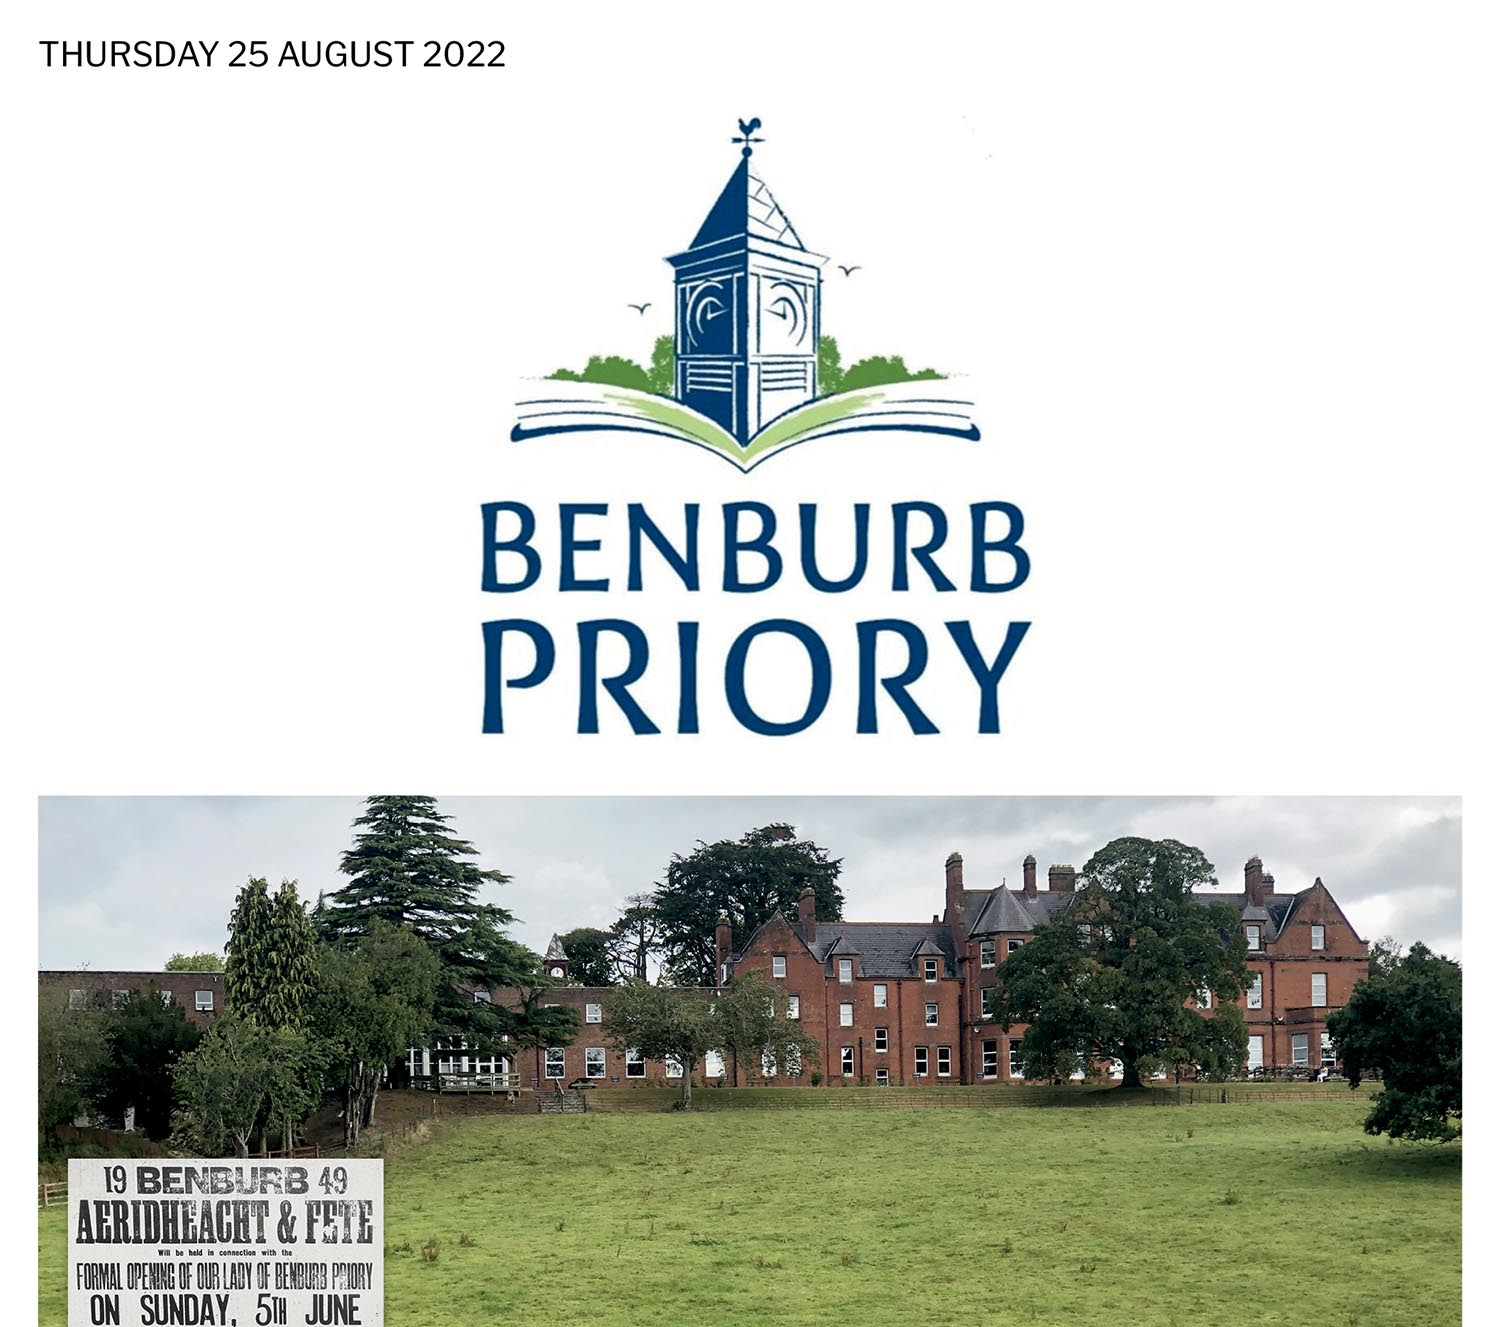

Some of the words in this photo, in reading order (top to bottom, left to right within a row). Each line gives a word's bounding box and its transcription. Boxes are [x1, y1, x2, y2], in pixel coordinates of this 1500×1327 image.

[136, 1166, 310, 1195] BENBURB
[75, 1199, 270, 1245] AERIDHEACHT
[276, 1199, 298, 1244] &
[304, 1199, 373, 1245] FETE
[157, 1249, 171, 1257] Will
[175, 1249, 184, 1257] be
[188, 1248, 203, 1257] held
[207, 1248, 215, 1257] in
[218, 1248, 257, 1257] connection
[261, 1248, 277, 1257] with
[281, 1249, 293, 1257] the
[76, 1262, 124, 1291] FORMAL
[126, 1262, 176, 1291] OPENING
[178, 1262, 193, 1291] OF
[196, 1262, 220, 1290] OUR
[223, 1261, 253, 1290] LADY
[256, 1261, 271, 1290] OF
[274, 1261, 328, 1291] BENBURB
[332, 1262, 373, 1290] PRIORY
[90, 1293, 120, 1326] ON
[305, 1293, 362, 1326] JUNE
